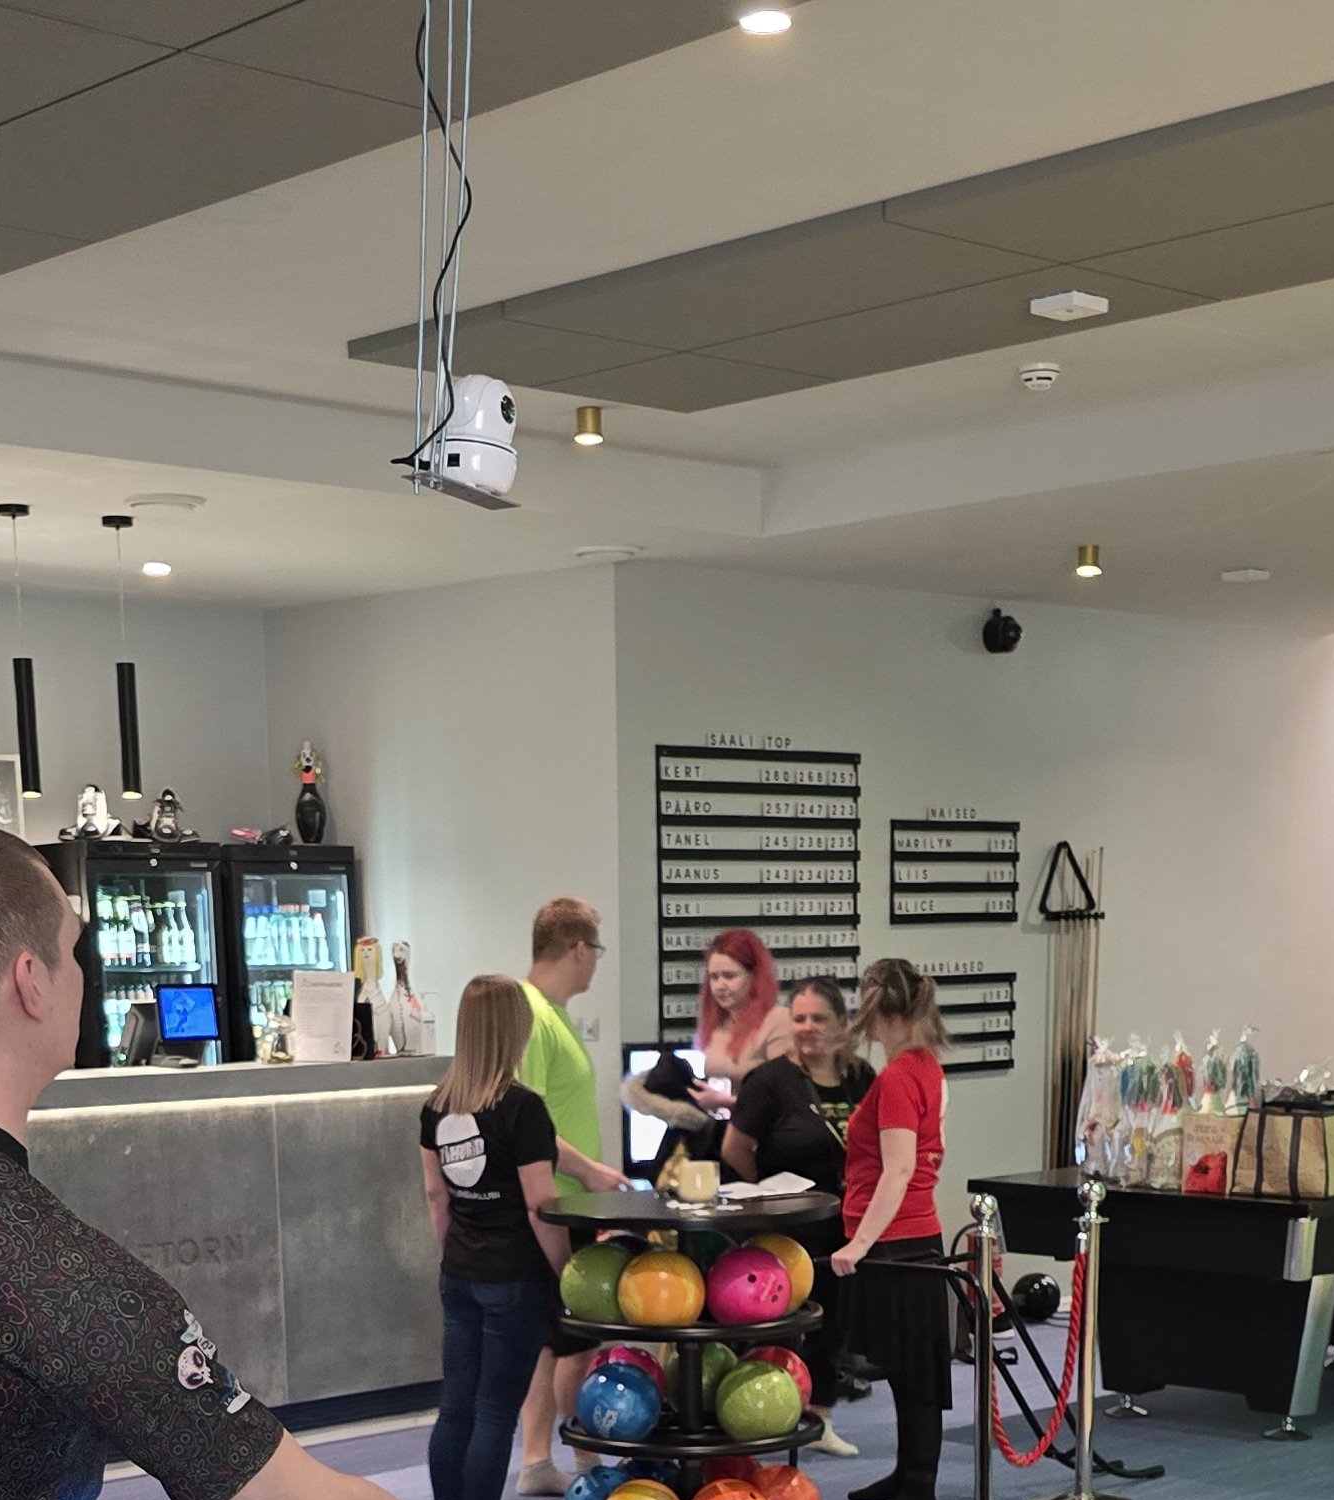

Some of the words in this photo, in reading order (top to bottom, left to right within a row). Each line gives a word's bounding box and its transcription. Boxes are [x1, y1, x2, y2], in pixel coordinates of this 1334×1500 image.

[767, 736, 791, 749] TOP
[664, 766, 701, 778] KERT
[766, 803, 790, 815] 257
[666, 833, 710, 846] TANEL
[666, 868, 720, 880] JAANUS
[897, 900, 934, 912] ALICE
